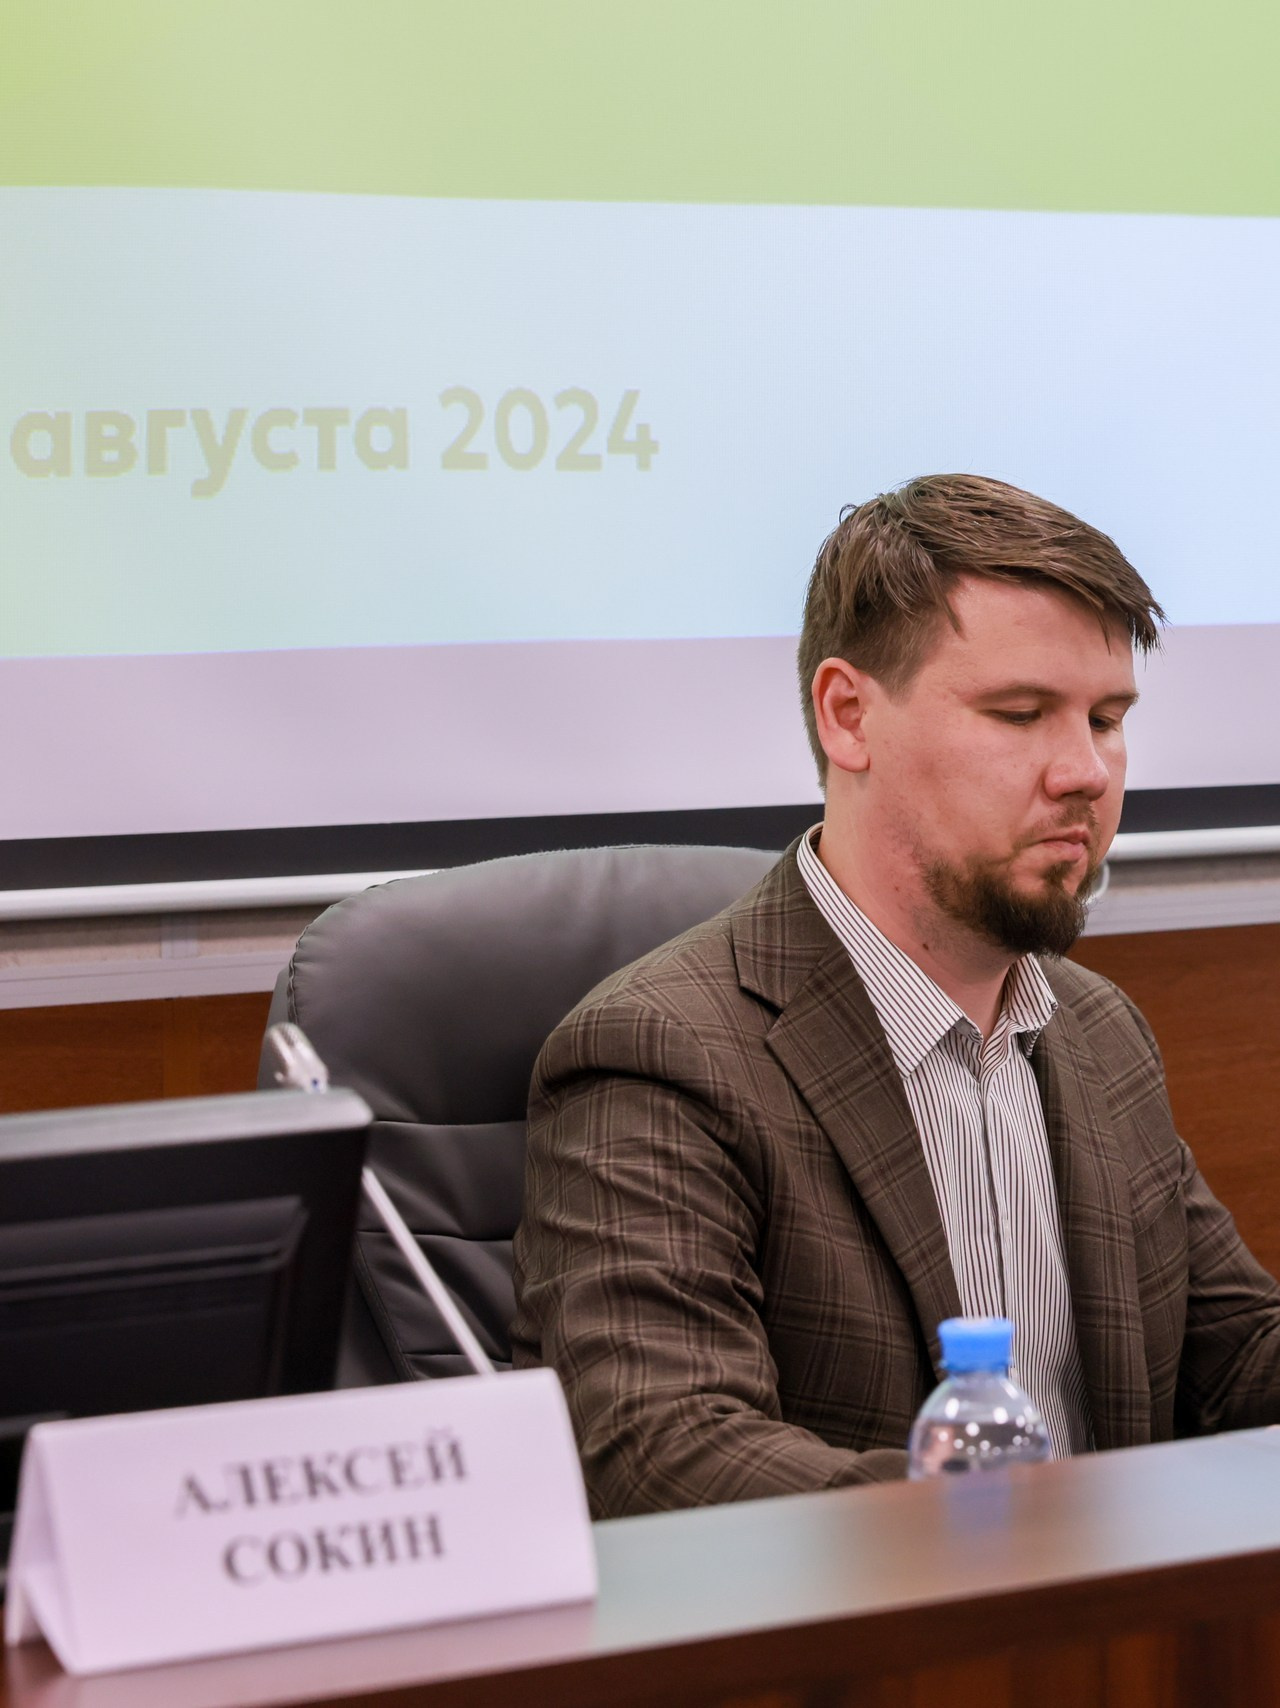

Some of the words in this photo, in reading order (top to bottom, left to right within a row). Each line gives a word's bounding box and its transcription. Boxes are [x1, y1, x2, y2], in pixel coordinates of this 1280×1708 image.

[10, 406, 410, 498] августа
[438, 385, 660, 472] 2024
[174, 1427, 468, 1518] АЛЕКСЕЙ
[221, 1513, 445, 1588] СОКИН
